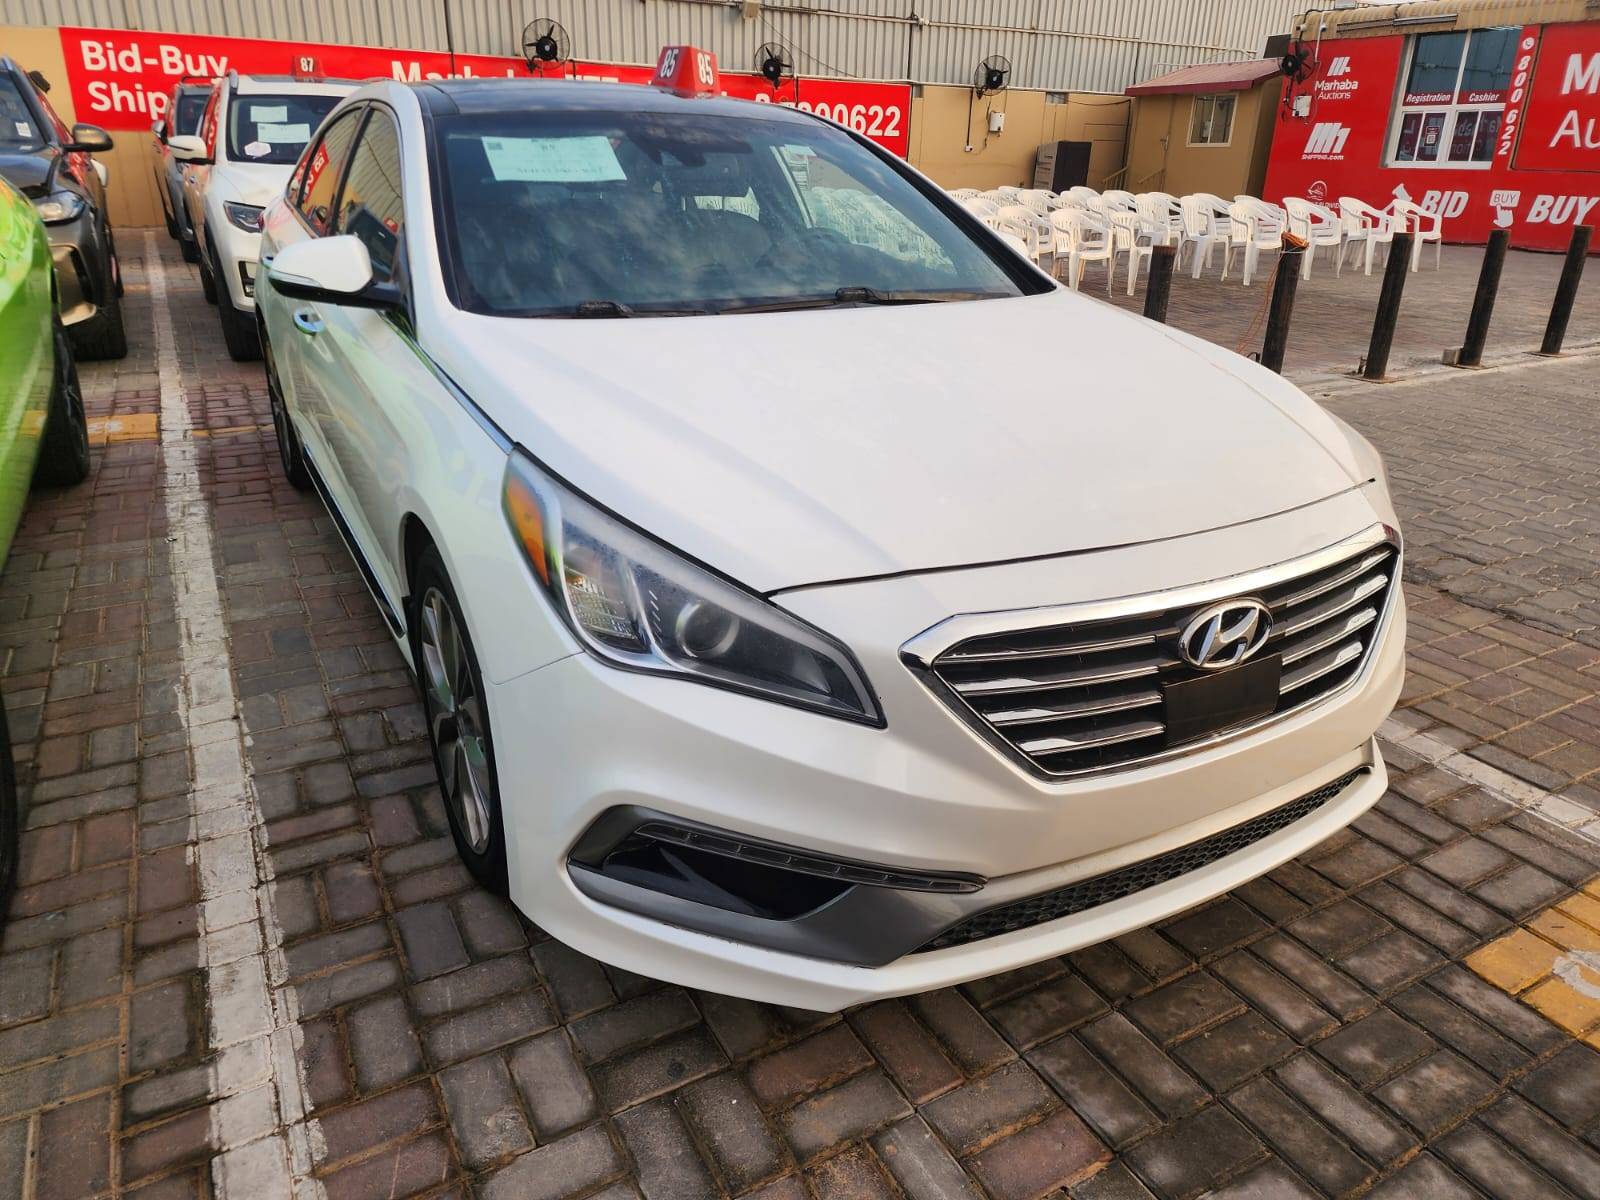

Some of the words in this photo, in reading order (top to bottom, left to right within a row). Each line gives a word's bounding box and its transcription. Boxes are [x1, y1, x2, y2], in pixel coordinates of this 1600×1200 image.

[80, 40, 228, 85] Bid-Buy
[300, 57, 314, 72] 87
[660, 49, 679, 78] 85
[697, 52, 714, 86] 85
[1314, 79, 1359, 91] Marhaba
[1317, 91, 1351, 100] Auctions
[87, 81, 168, 121] Ship
[1406, 93, 1451, 104] Registration
[1469, 93, 1500, 102] Cashier
[1421, 190, 1469, 218] BID
[1493, 193, 1517, 204] BUY
[1526, 195, 1600, 225] BUY
